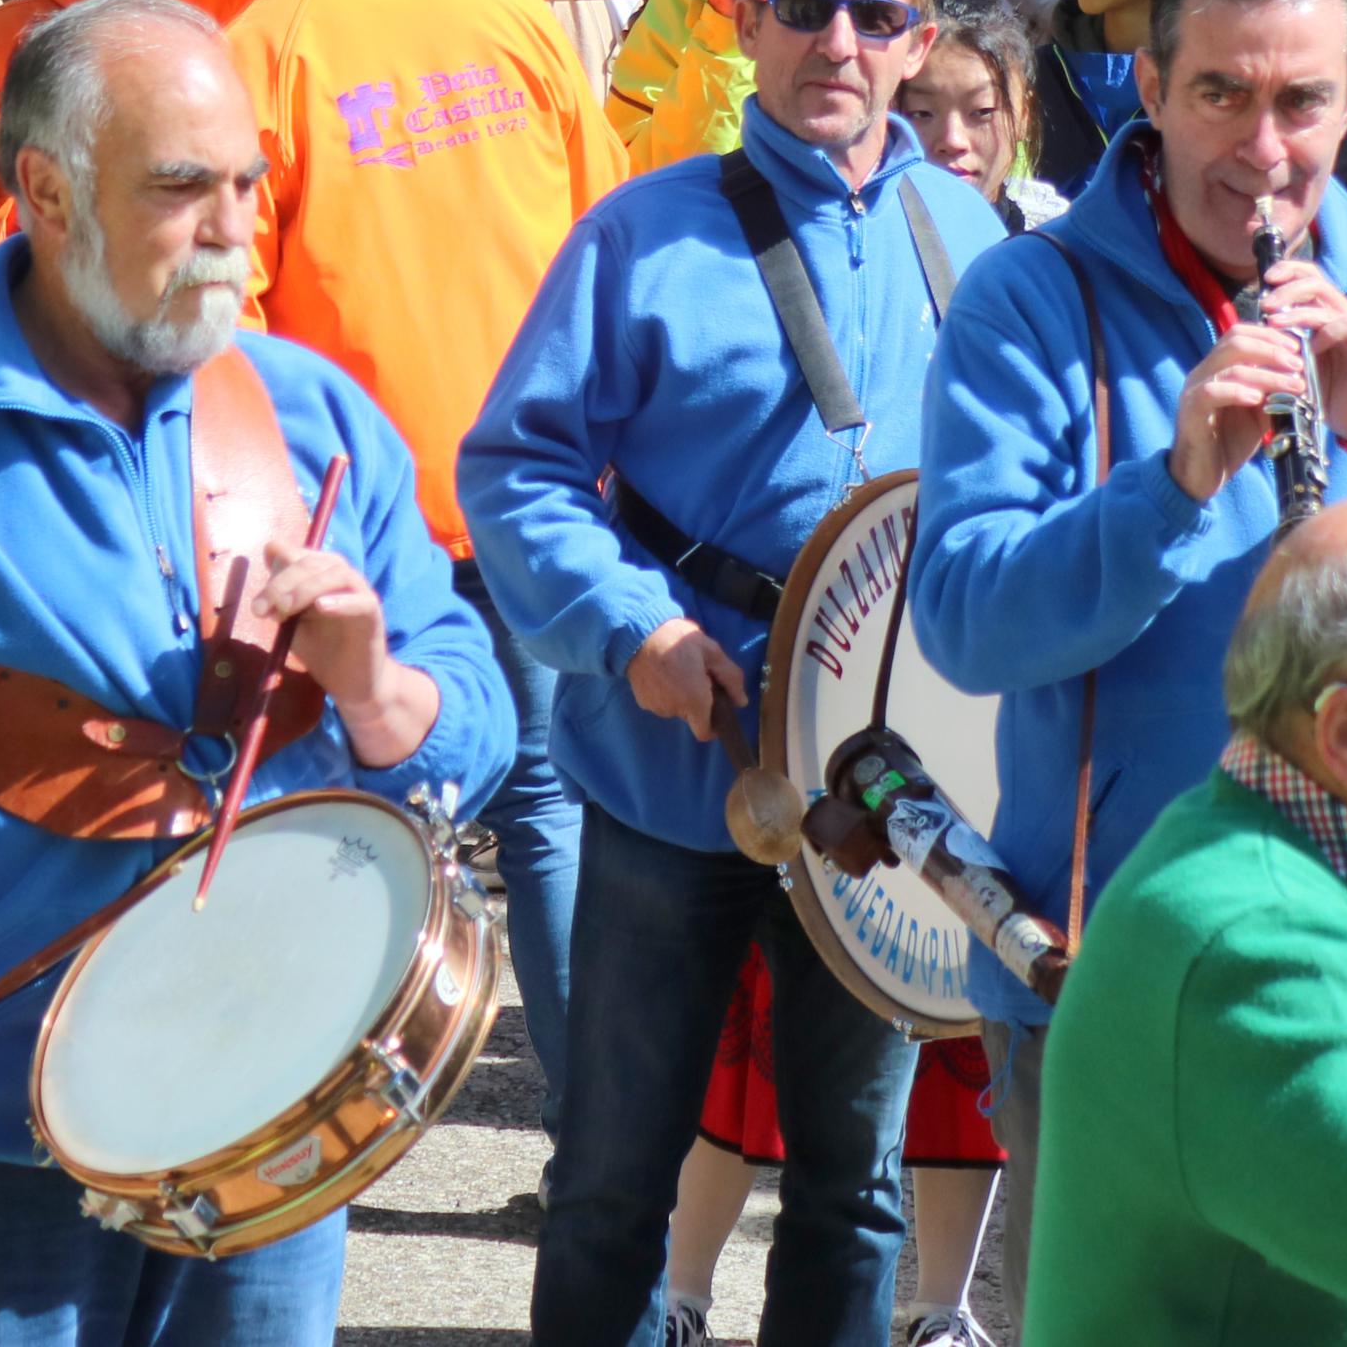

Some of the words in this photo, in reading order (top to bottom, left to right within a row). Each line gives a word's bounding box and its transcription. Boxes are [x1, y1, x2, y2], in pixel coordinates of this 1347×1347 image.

[416, 63, 501, 104] Peña
[405, 87, 526, 133] Castilla
[415, 128, 481, 156] Desde
